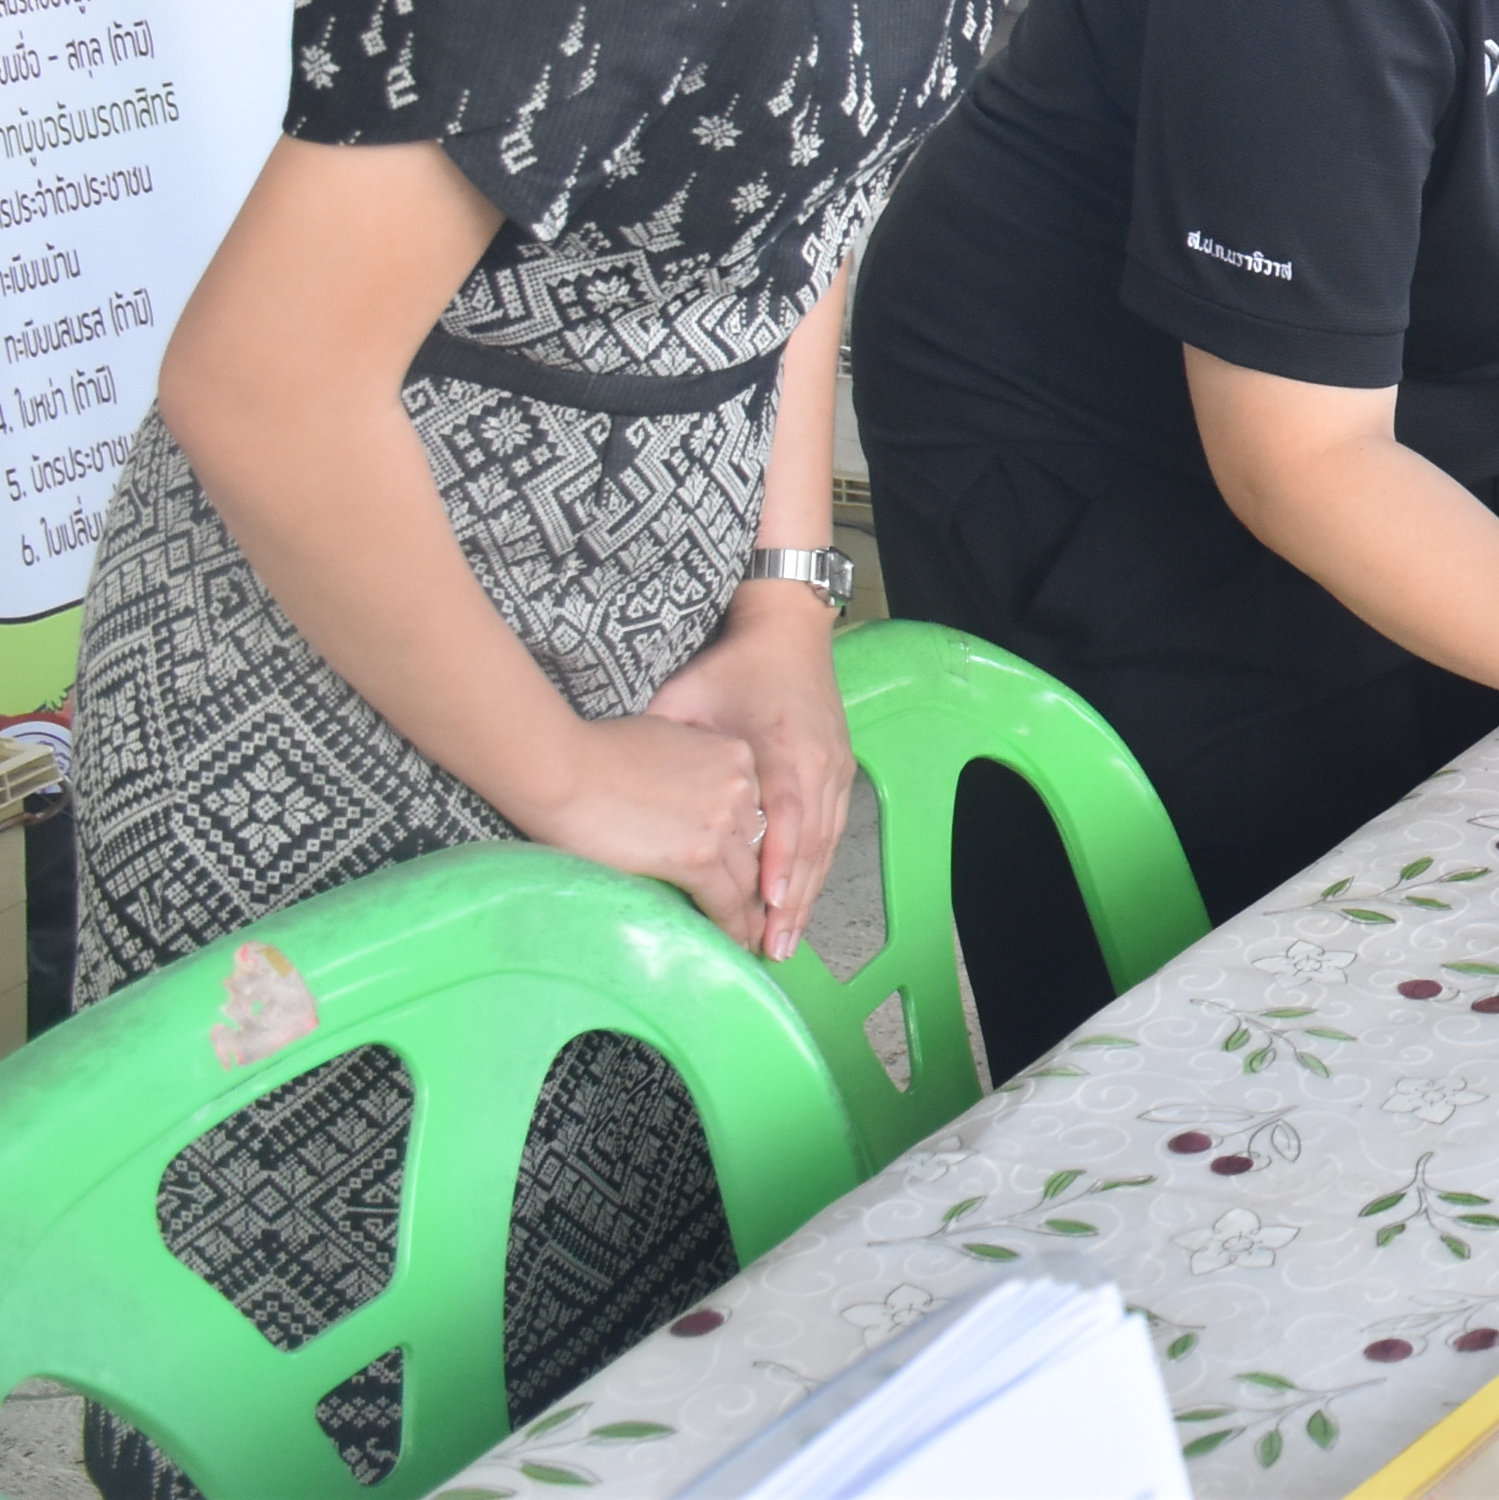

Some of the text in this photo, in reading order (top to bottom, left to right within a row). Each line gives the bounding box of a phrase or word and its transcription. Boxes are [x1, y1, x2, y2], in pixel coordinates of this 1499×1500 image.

[65, 36, 105, 79] สกุล
[108, 20, 155, 67] (ถ้ามี)
[109, 288, 154, 337] (ถ้ามี)
[14, 378, 68, 429] ใบหย่า
[70, 365, 117, 416] (ถ้ามี)
[5, 468, 27, 501] 5.
[21, 535, 40, 566] 6.
